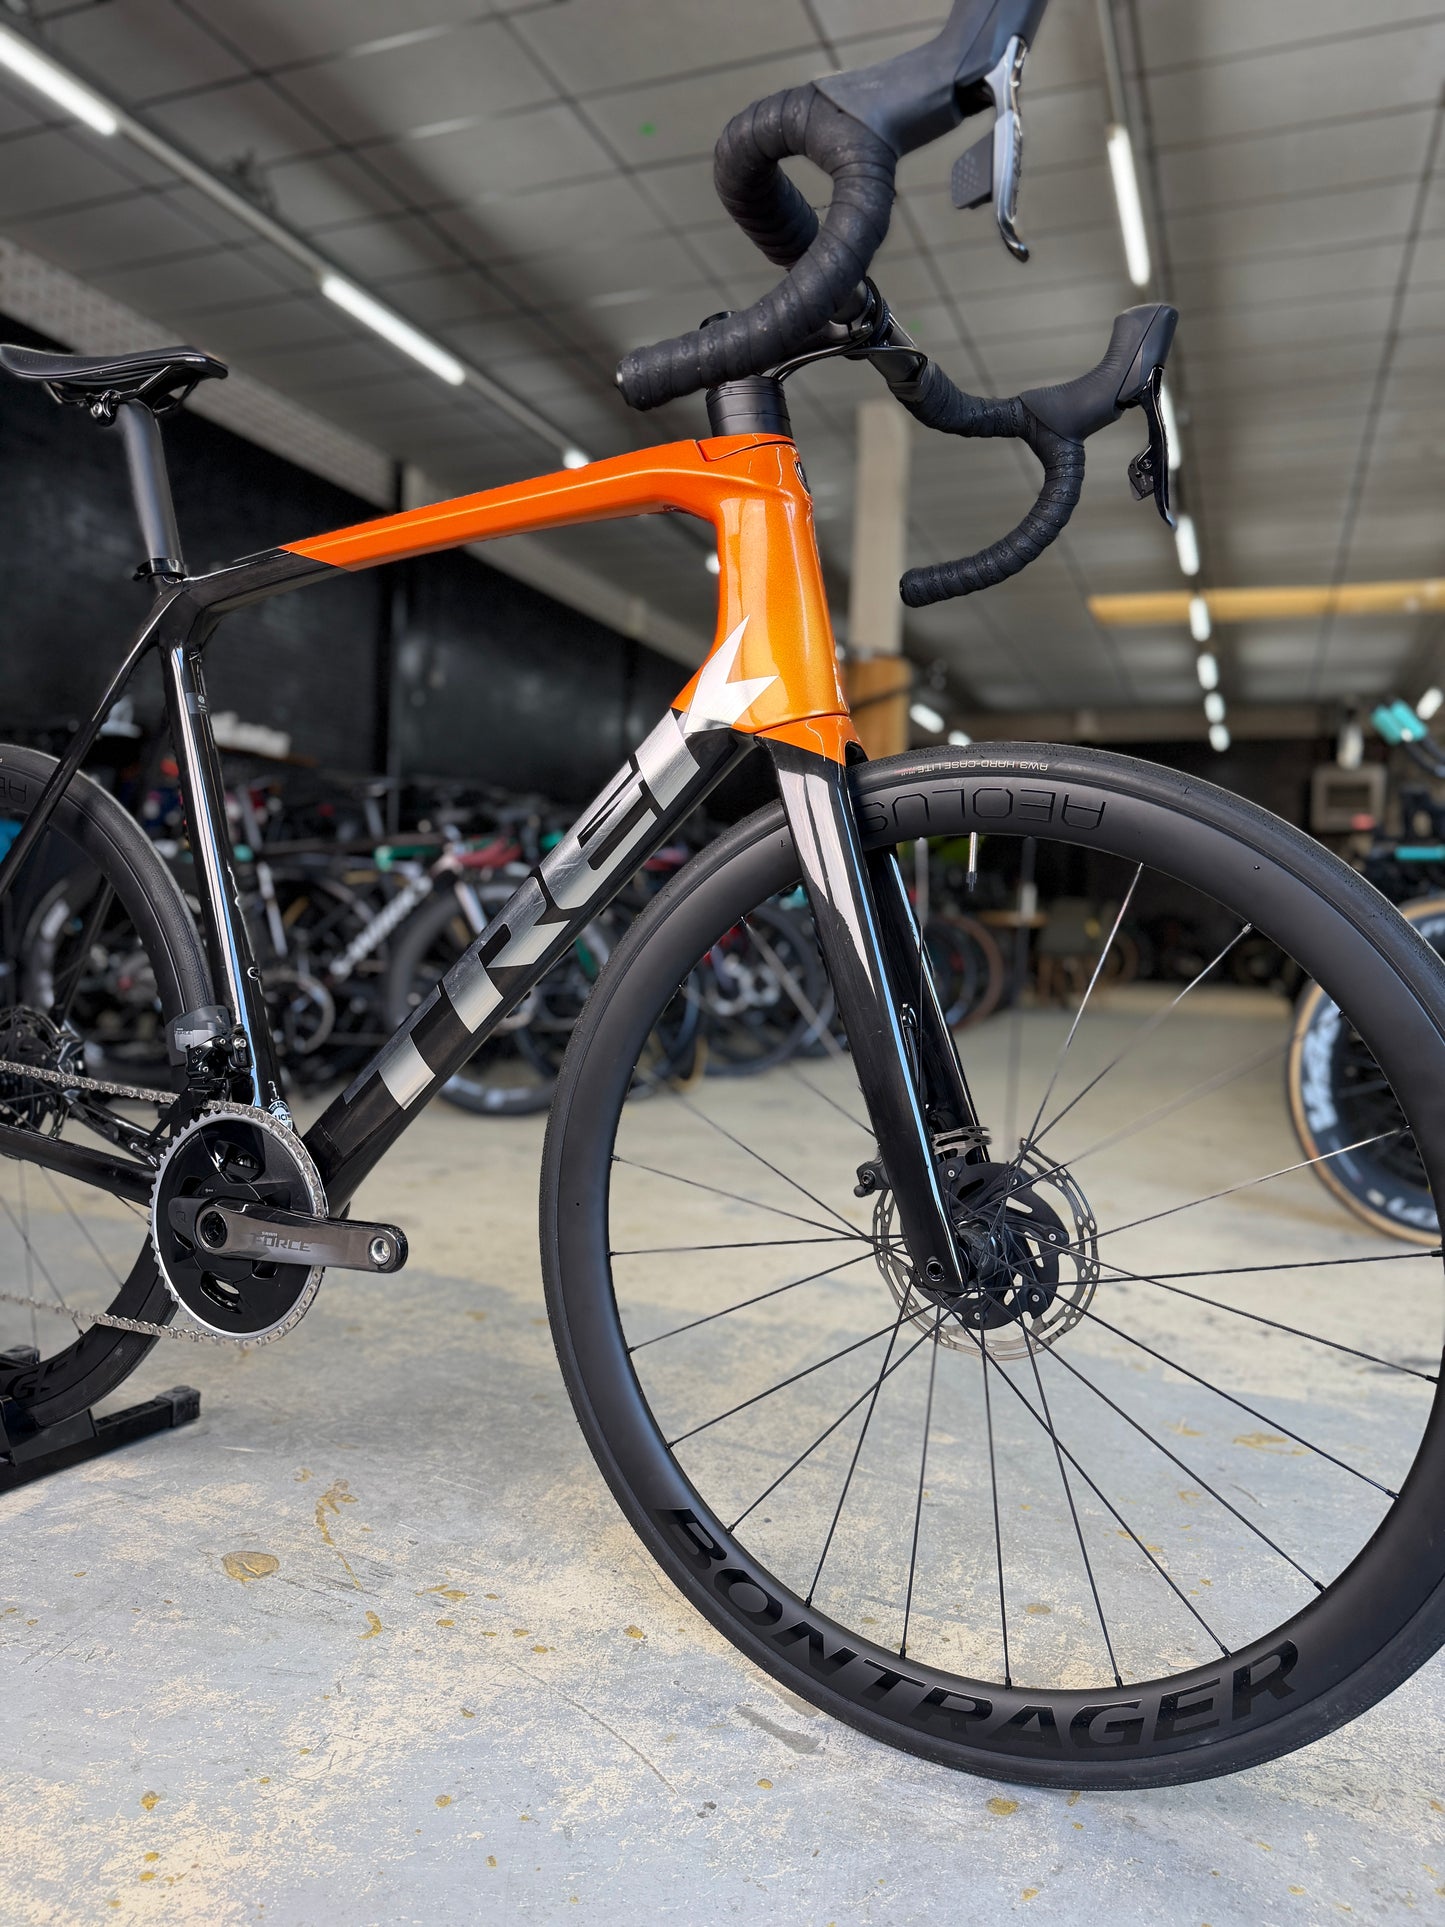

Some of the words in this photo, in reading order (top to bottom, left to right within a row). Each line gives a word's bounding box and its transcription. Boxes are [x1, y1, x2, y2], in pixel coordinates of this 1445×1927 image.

[917, 762, 942, 774] LITE
[944, 759, 1015, 770] HARD-CASE
[1020, 760, 1049, 771] AW3
[860, 787, 1107, 834] AEOLUS
[342, 614, 779, 1110] TREK
[661, 1506, 1299, 1749] BONTRAGER
